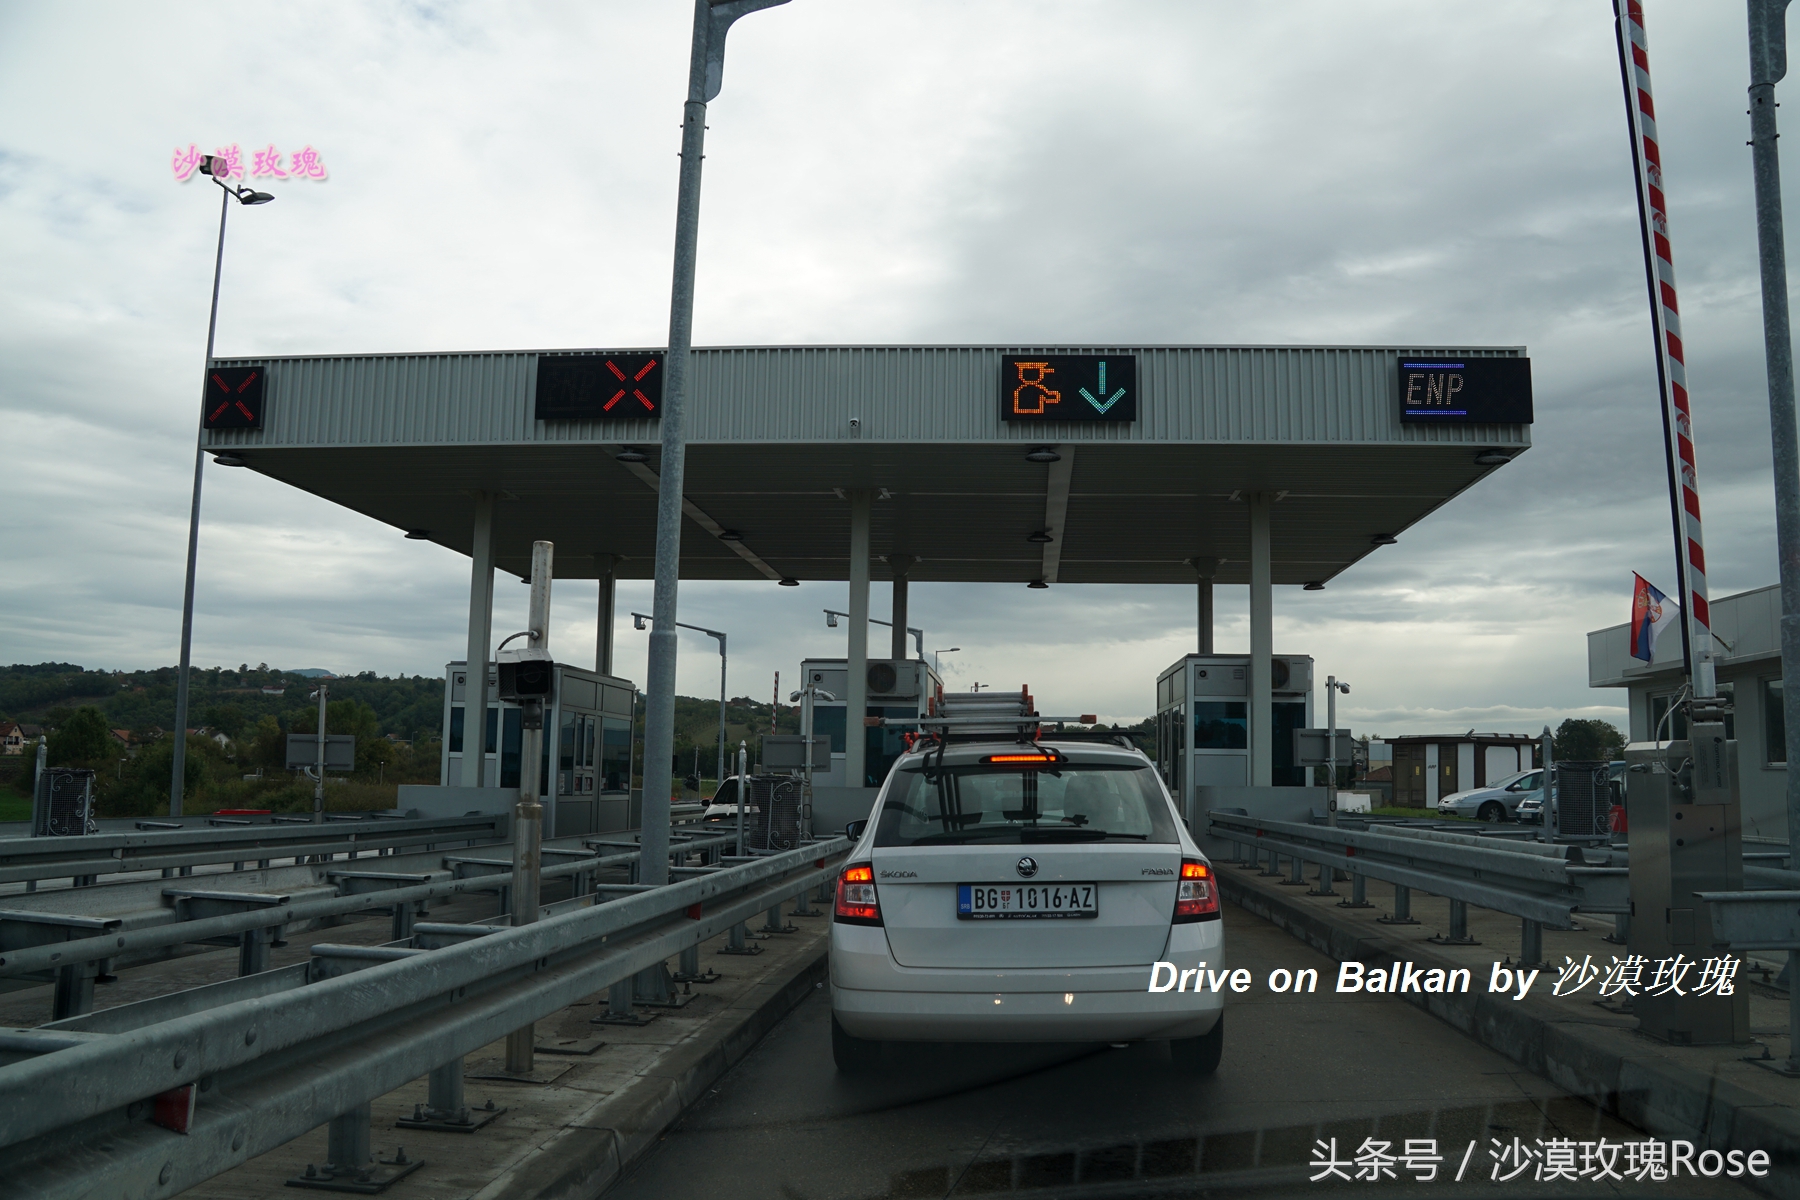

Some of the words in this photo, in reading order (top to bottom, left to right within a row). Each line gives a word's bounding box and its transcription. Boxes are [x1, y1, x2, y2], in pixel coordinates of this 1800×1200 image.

[1406, 373, 1465, 405] ENP
[1141, 867, 1174, 876] FABIA
[974, 888, 998, 909] BG
